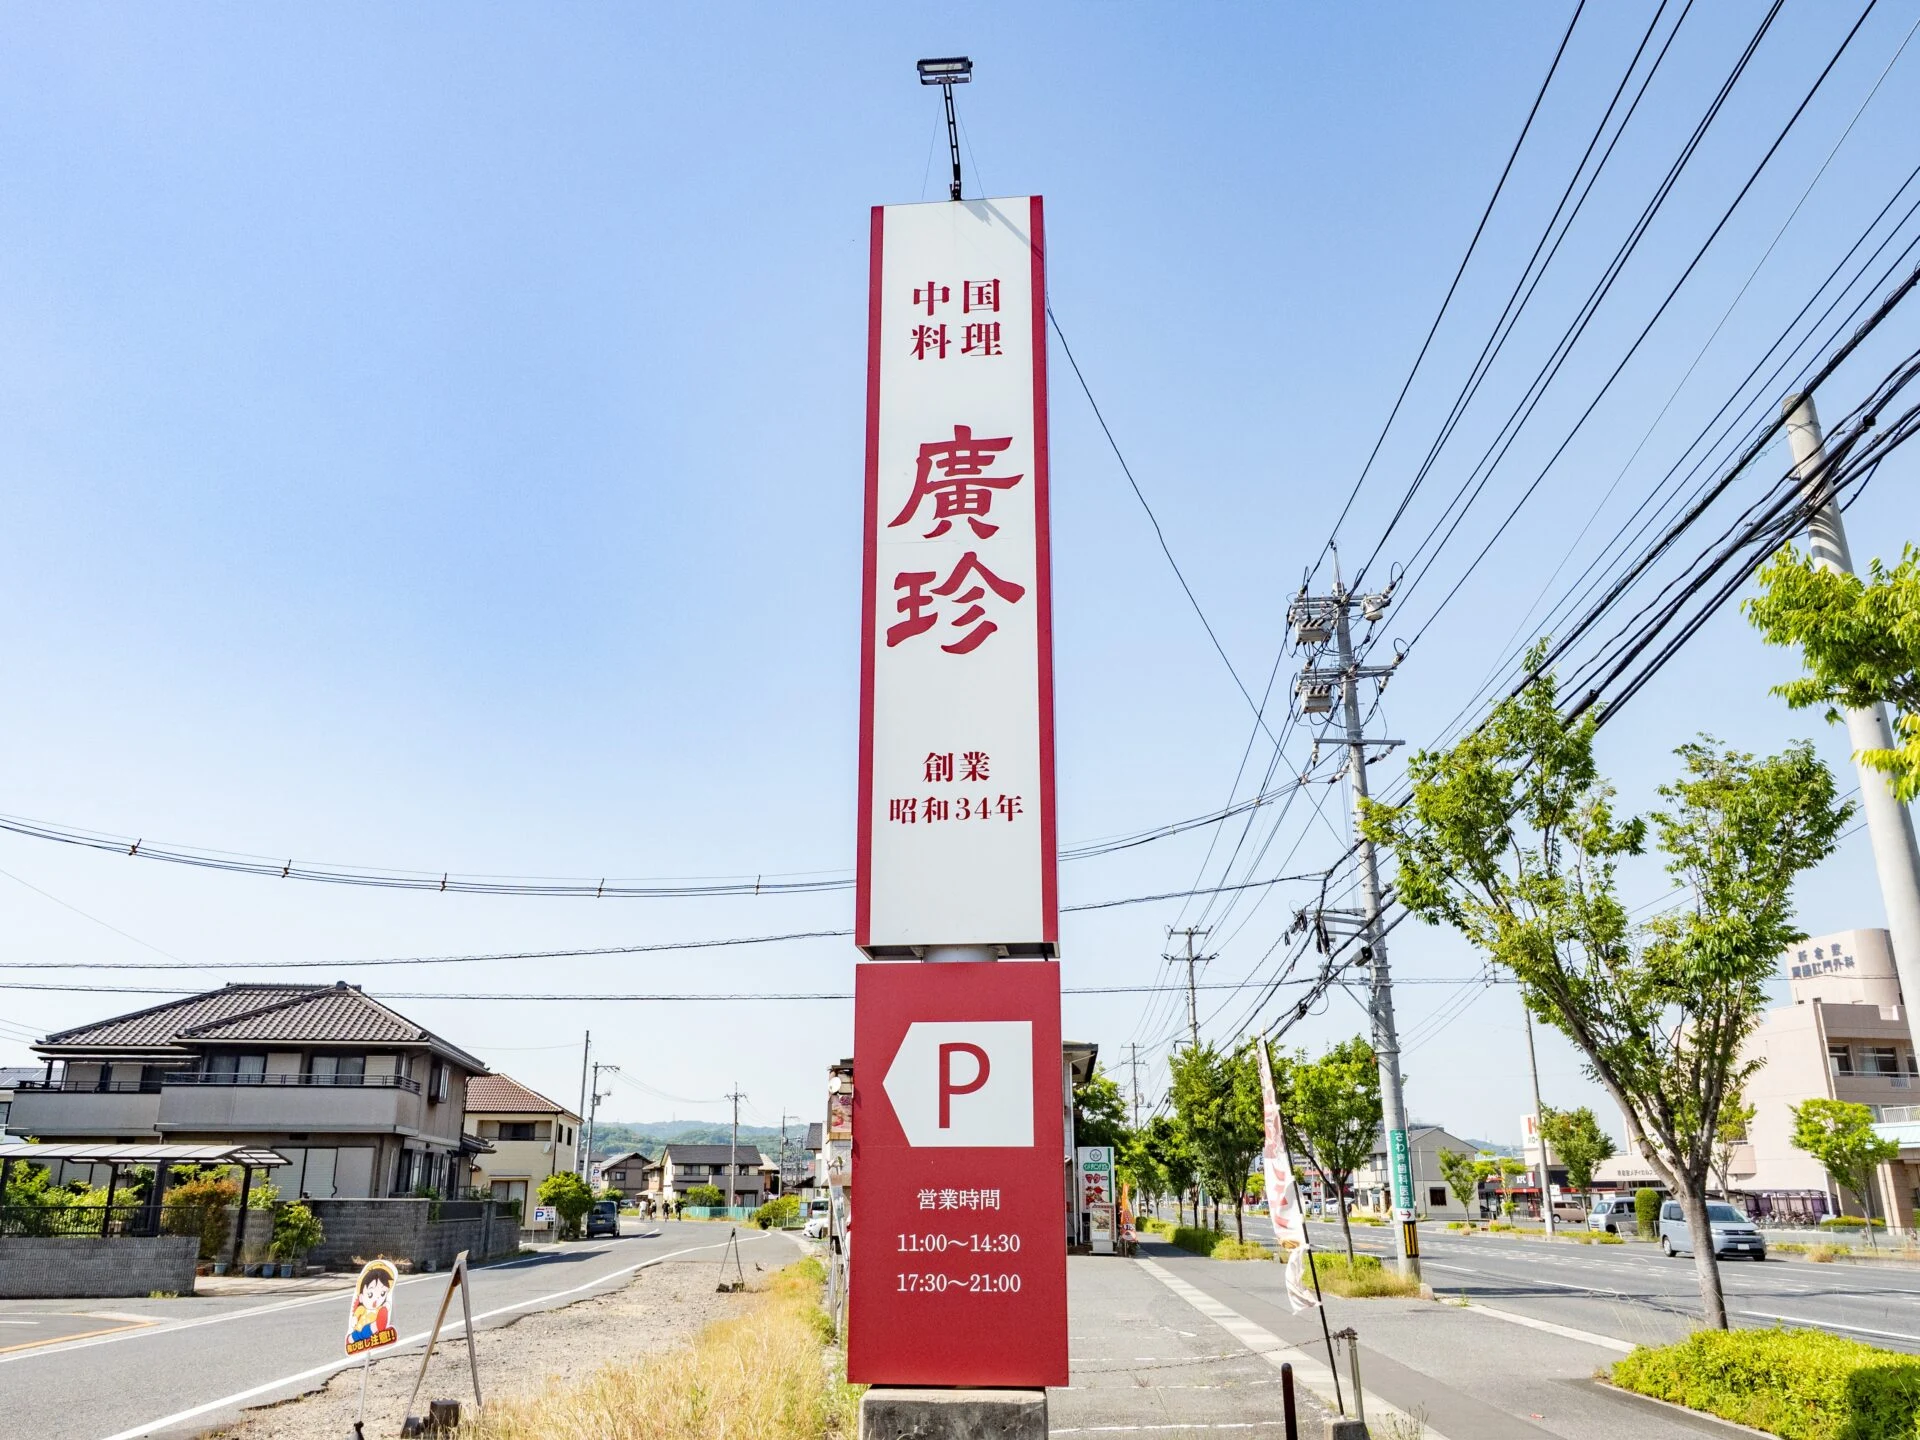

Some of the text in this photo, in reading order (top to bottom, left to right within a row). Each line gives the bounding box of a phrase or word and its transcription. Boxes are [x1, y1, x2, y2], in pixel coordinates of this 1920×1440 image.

[912, 278, 1000, 316] 中国
[910, 321, 1003, 361] 料理
[886, 424, 1026, 655] 廣珍
[922, 751, 990, 782] 創業
[889, 794, 1024, 824] 昭和34年
[939, 1042, 991, 1129] P
[917, 1189, 1001, 1210] 営業時間
